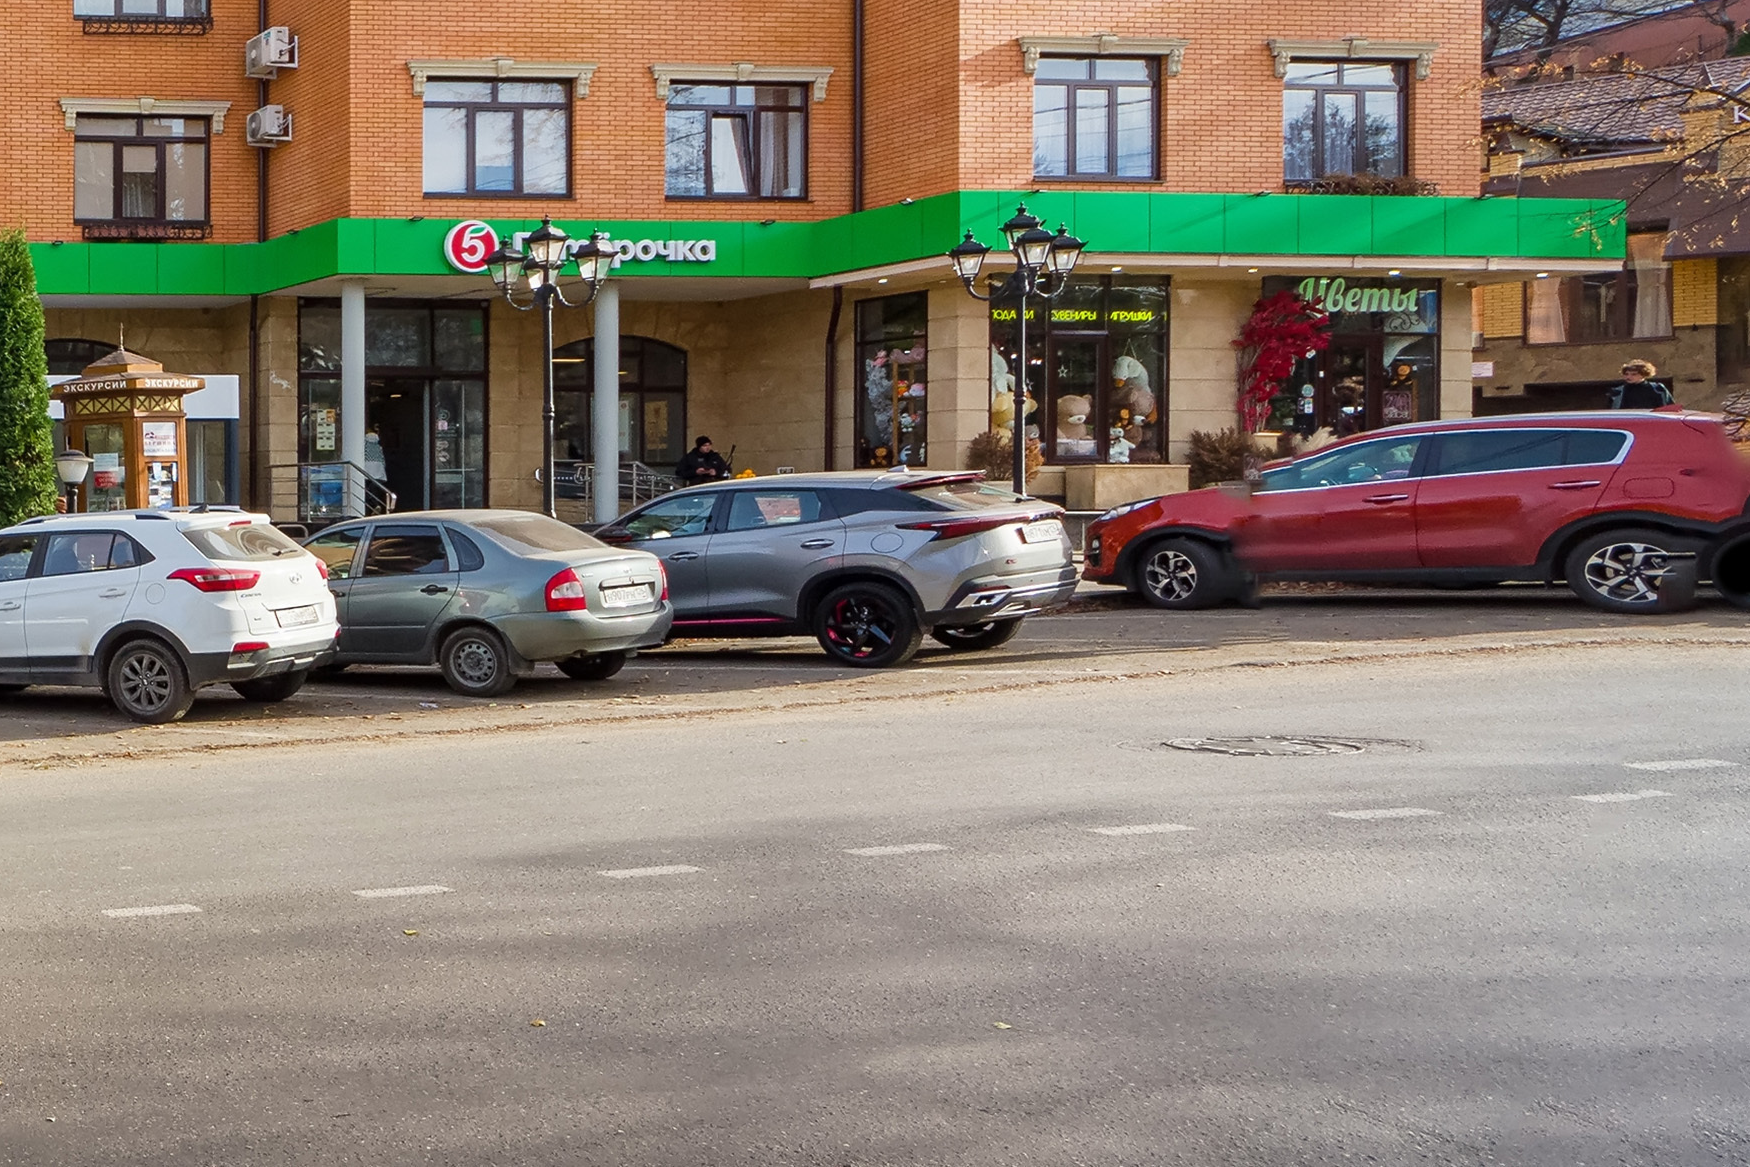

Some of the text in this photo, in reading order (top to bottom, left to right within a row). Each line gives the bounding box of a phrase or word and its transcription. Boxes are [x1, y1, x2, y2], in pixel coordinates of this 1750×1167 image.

[512, 231, 716, 269] Птрочка
[1298, 277, 1418, 312] Цветы
[63, 381, 127, 393] ЭКСКУРСИИ
[145, 378, 199, 388] ЭКСКУРСИИ
